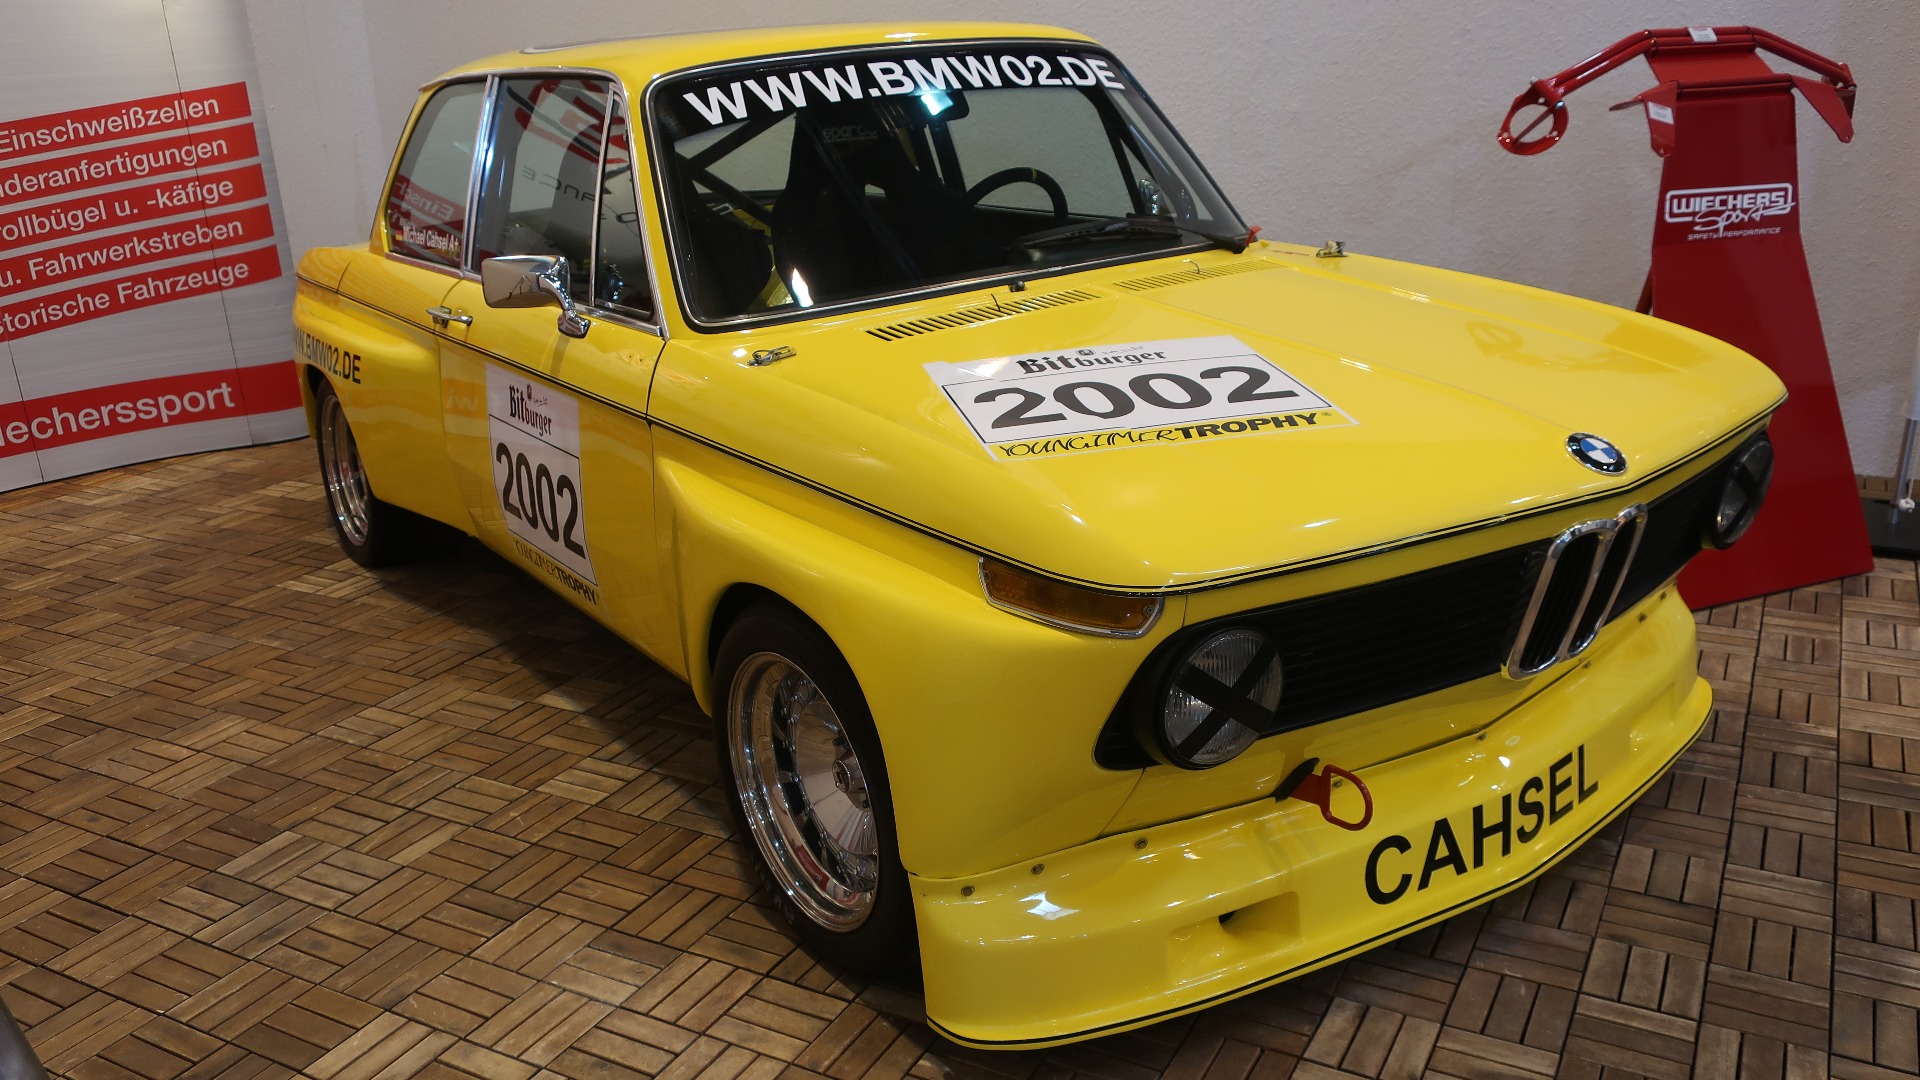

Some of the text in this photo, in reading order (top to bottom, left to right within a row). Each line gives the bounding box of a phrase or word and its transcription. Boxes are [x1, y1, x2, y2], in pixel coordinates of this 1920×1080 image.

[683, 54, 1126, 125] WWW.BMW02.DE
[0, 98, 219, 153] Einschweißzellen
[0, 138, 228, 197] deranfertigungen
[0, 180, 234, 240] ollbügel u. -käfige
[1672, 191, 1786, 213] WIECHERS
[28, 219, 243, 280] Fahrwerkstreben
[403, 225, 426, 245] Michael
[117, 262, 249, 304] Fahrzeuge
[1016, 351, 1167, 374] Bitburger
[509, 384, 552, 436] Bitburger
[973, 366, 1300, 430] 2002
[496, 442, 586, 560] 2002
[1365, 744, 1599, 905] CAHSEL
